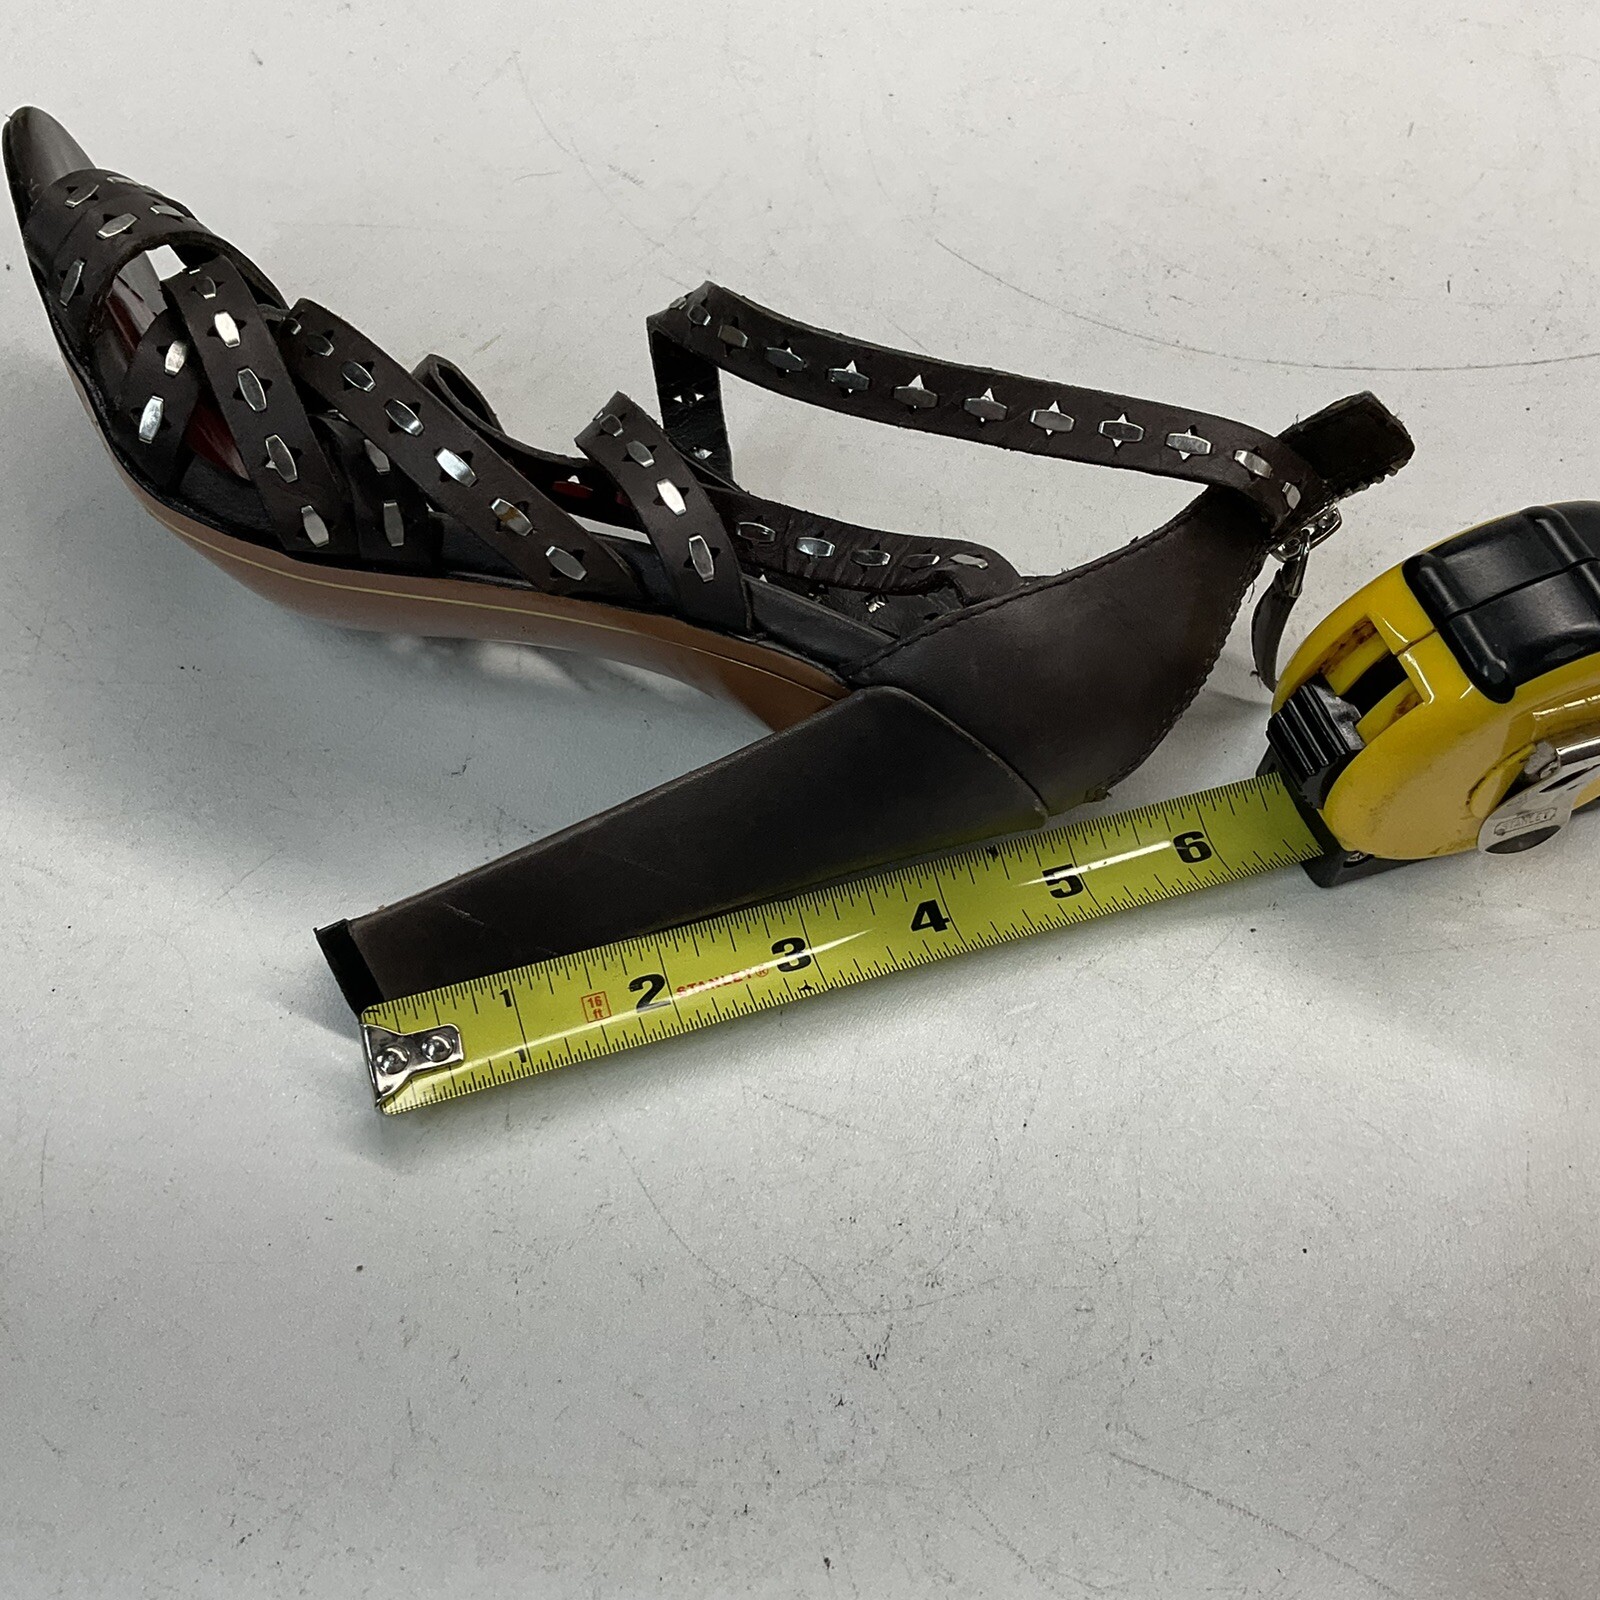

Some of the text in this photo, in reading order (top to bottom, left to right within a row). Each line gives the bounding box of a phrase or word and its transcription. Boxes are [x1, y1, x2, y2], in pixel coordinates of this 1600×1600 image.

[1173, 831, 1212, 864] 6
[1041, 864, 1084, 899] 5
[910, 900, 950, 933] 4
[771, 937, 812, 972] 3
[499, 988, 512, 1008] 1
[587, 995, 603, 1008] 16
[628, 973, 671, 1014] 2
[513, 1048, 527, 1064] 1
